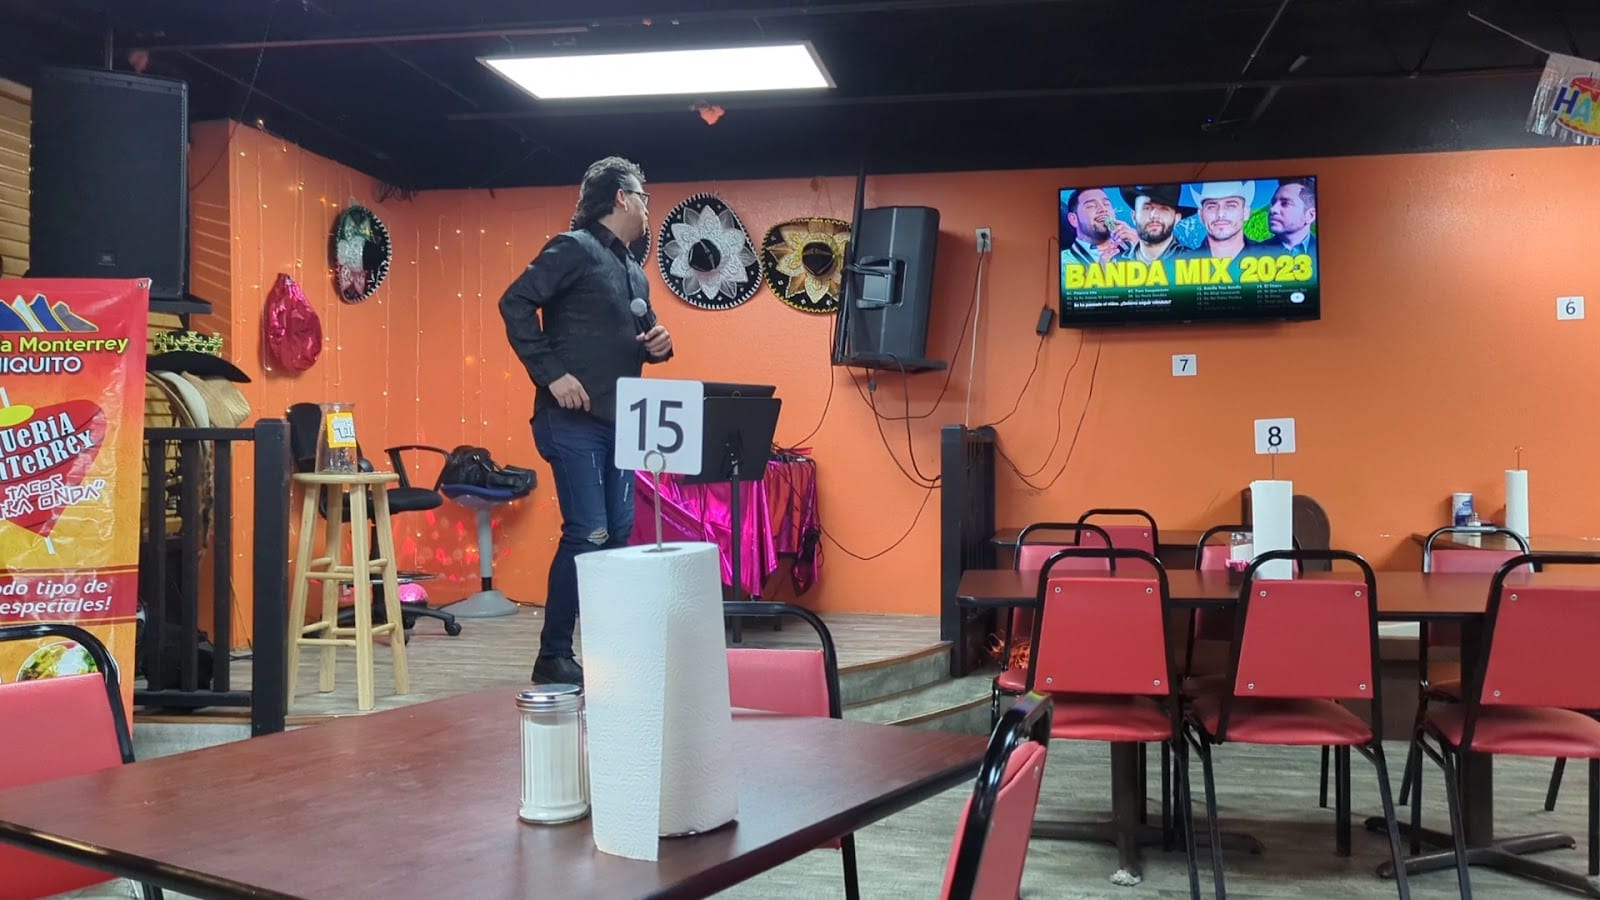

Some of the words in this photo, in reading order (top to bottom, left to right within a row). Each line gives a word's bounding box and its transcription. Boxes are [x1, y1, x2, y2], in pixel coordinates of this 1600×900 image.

[1552, 86, 1592, 124] HA
[1065, 261, 1169, 289] BANDA
[1175, 257, 1233, 285] MIX
[1239, 254, 1313, 283] 2023
[1566, 301, 1576, 315] 6
[20, 336, 129, 353] Monterrey
[0, 356, 82, 373] IQUITO
[1180, 359, 1189, 372] 7
[629, 398, 684, 454] 15
[1268, 426, 1282, 447] 8
[6, 474, 63, 501] TACOS
[0, 580, 28, 596] do
[36, 580, 77, 598] tipo
[84, 579, 108, 594] de
[0, 596, 112, 618] especiales!
